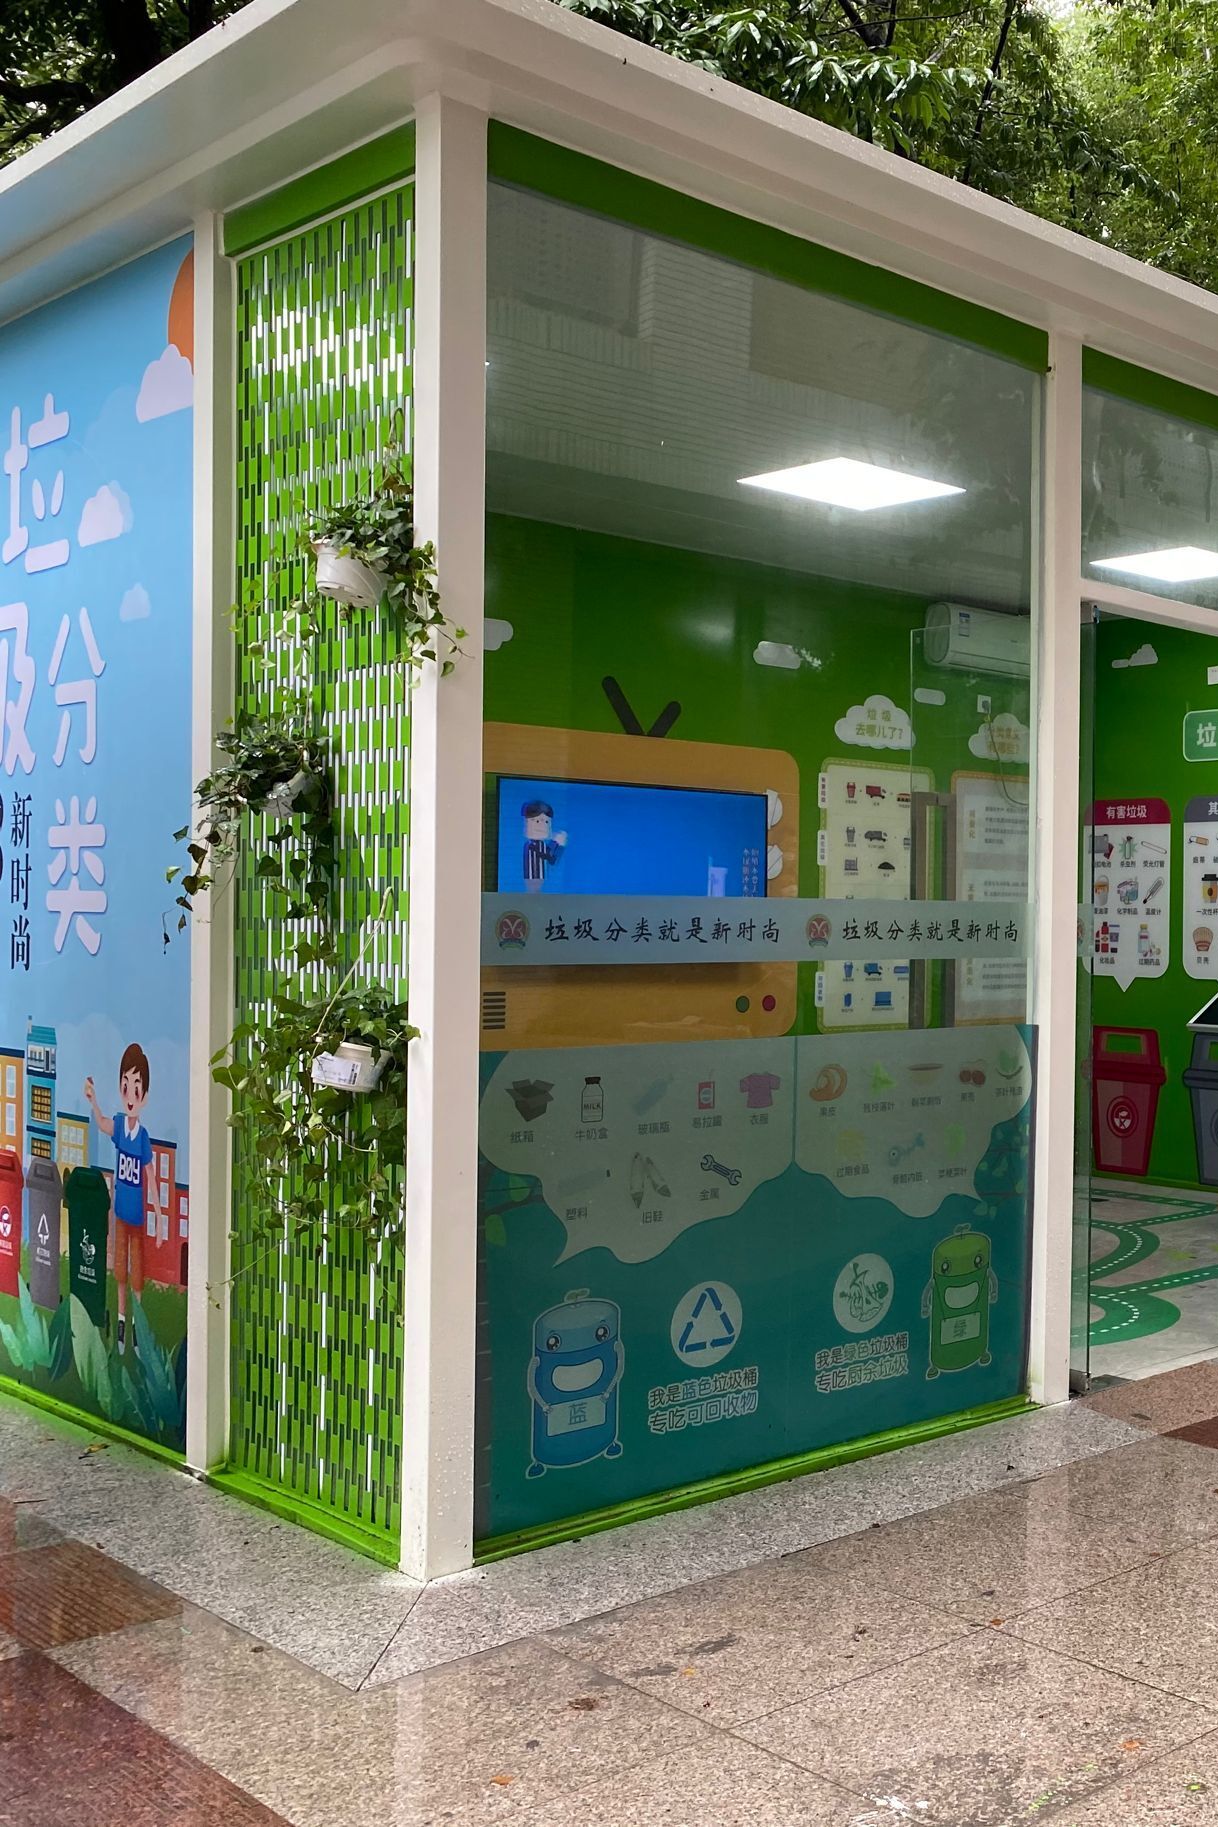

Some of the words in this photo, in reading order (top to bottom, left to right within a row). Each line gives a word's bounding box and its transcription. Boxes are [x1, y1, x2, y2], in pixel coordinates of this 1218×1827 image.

[866, 708, 892, 723] 垃圾
[46, 606, 108, 956] 分类
[1105, 804, 1148, 820] 有害垃圾
[10, 791, 33, 972] 新时尚
[544, 915, 781, 945] 垃圾分类就是新时尚
[841, 917, 1019, 944] 垃圾分类就是新时尚
[583, 1102, 601, 1111] MILK
[509, 1130, 535, 1145] 纸箱
[575, 1127, 609, 1142] 牛奶盒
[117, 1154, 141, 1185] BOY
[815, 1331, 909, 1371] 我是绿色垃圾桶
[648, 1366, 759, 1409] 我是蓝色垃圾桶
[815, 1353, 909, 1393] 专吃厨余垃圾
[567, 1402, 588, 1426] 蓝
[648, 1390, 759, 1435] 专吃可回收物
